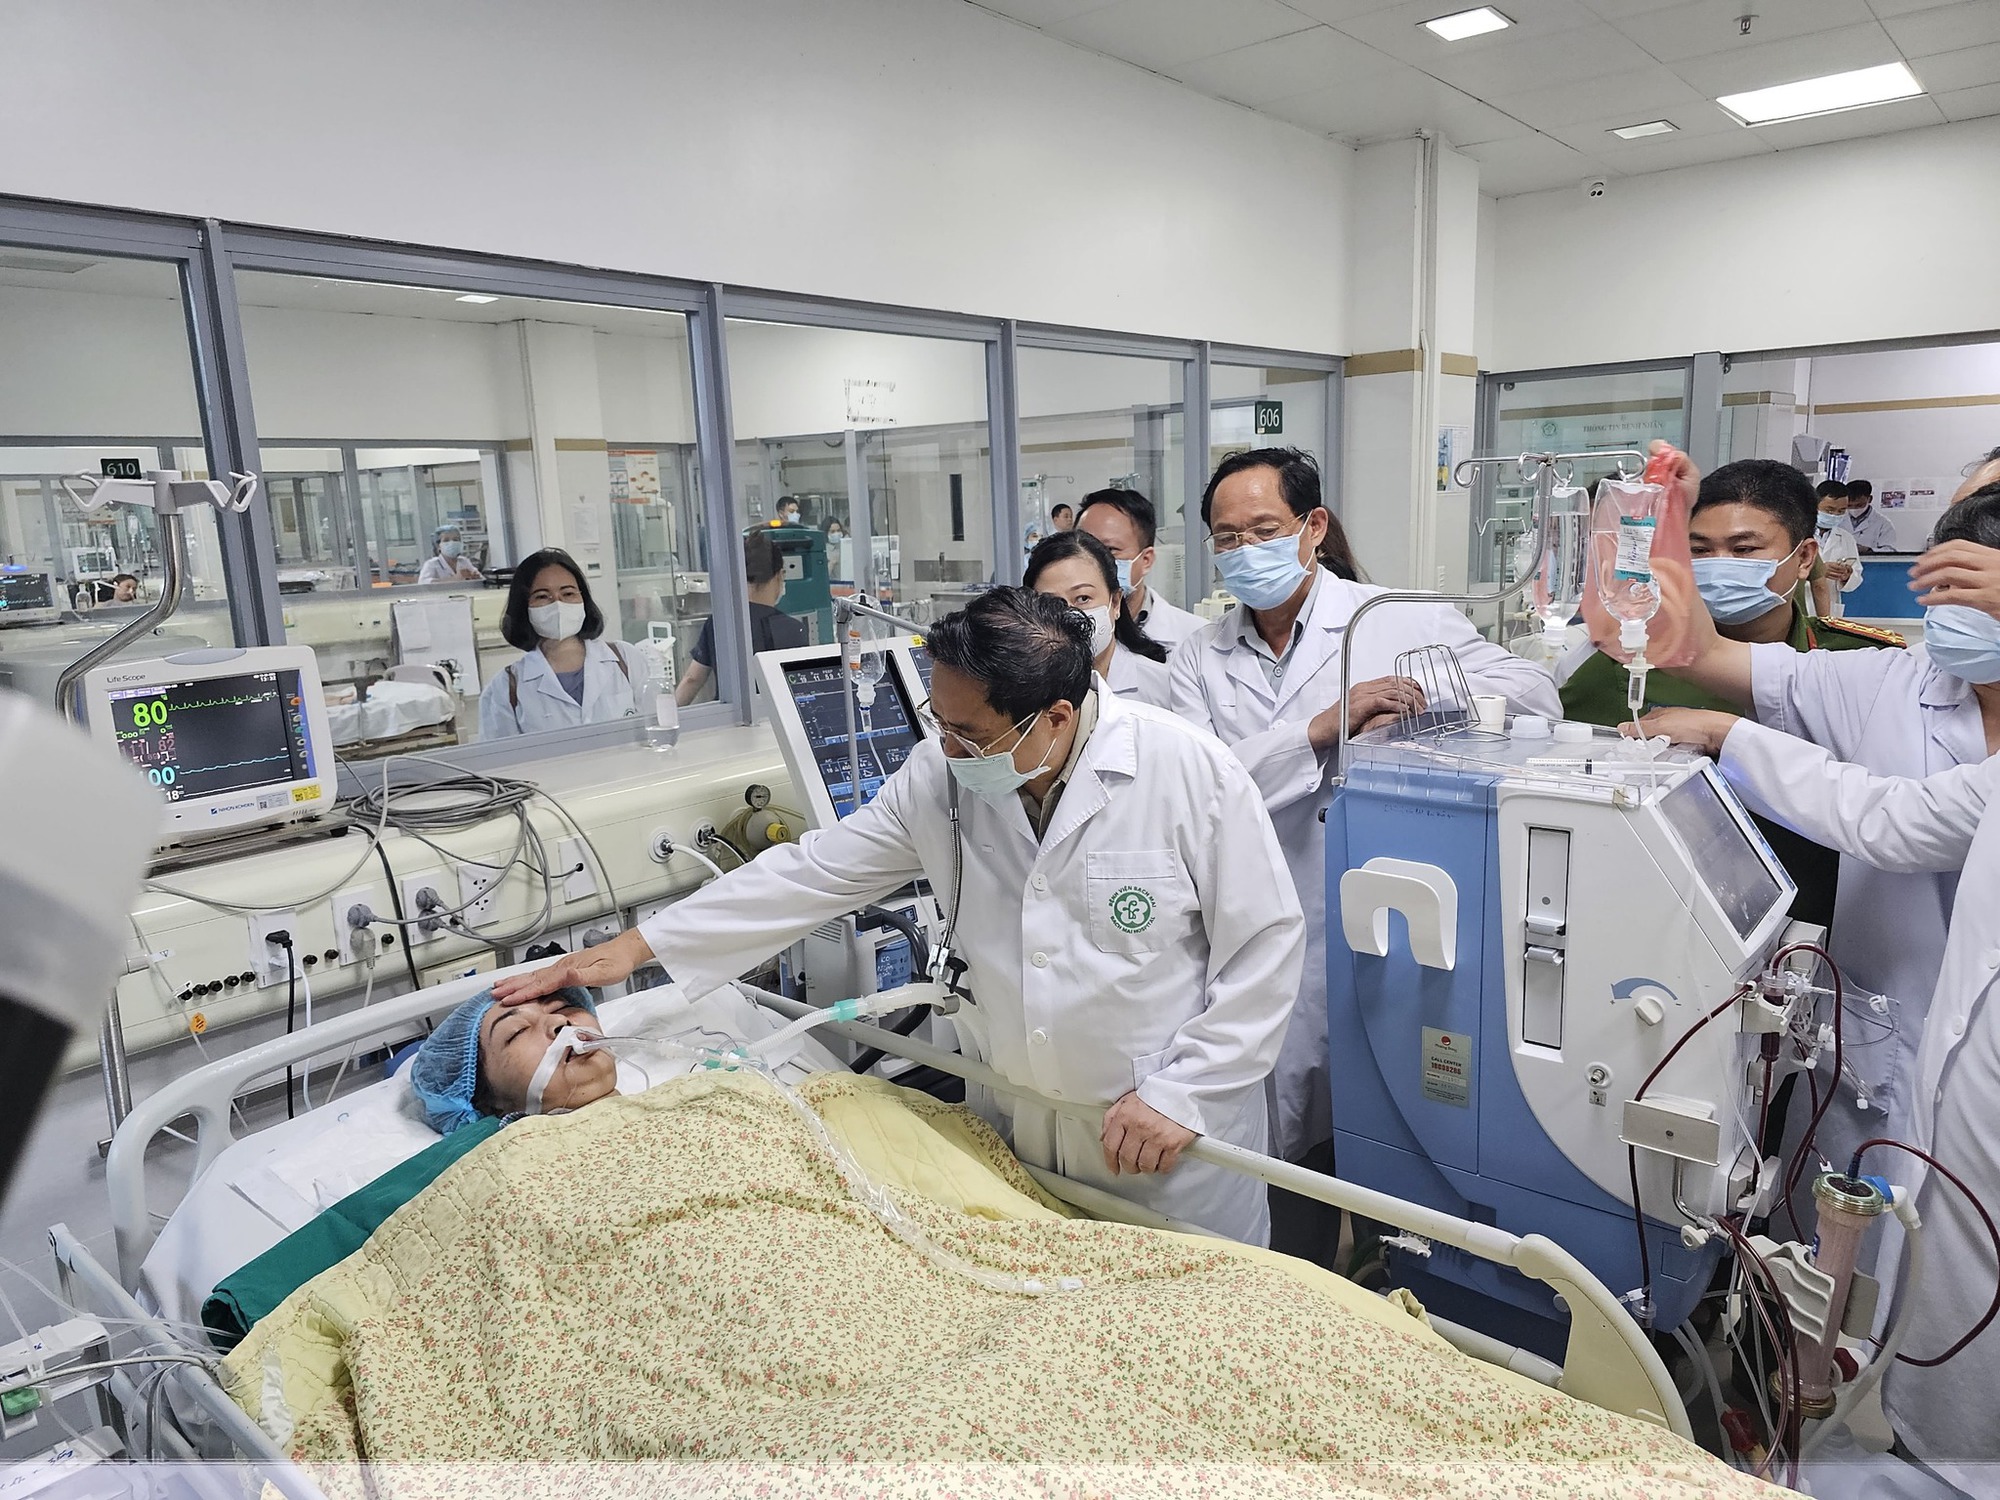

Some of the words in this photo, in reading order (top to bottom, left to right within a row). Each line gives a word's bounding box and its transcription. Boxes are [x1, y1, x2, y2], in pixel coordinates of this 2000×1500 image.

[1260, 408, 1280, 427] 606
[106, 462, 137, 476] 610
[133, 700, 168, 727] 80
[158, 739, 176, 752] 82
[166, 789, 180, 801] 18
[1443, 1059, 1462, 1067] CENTER
